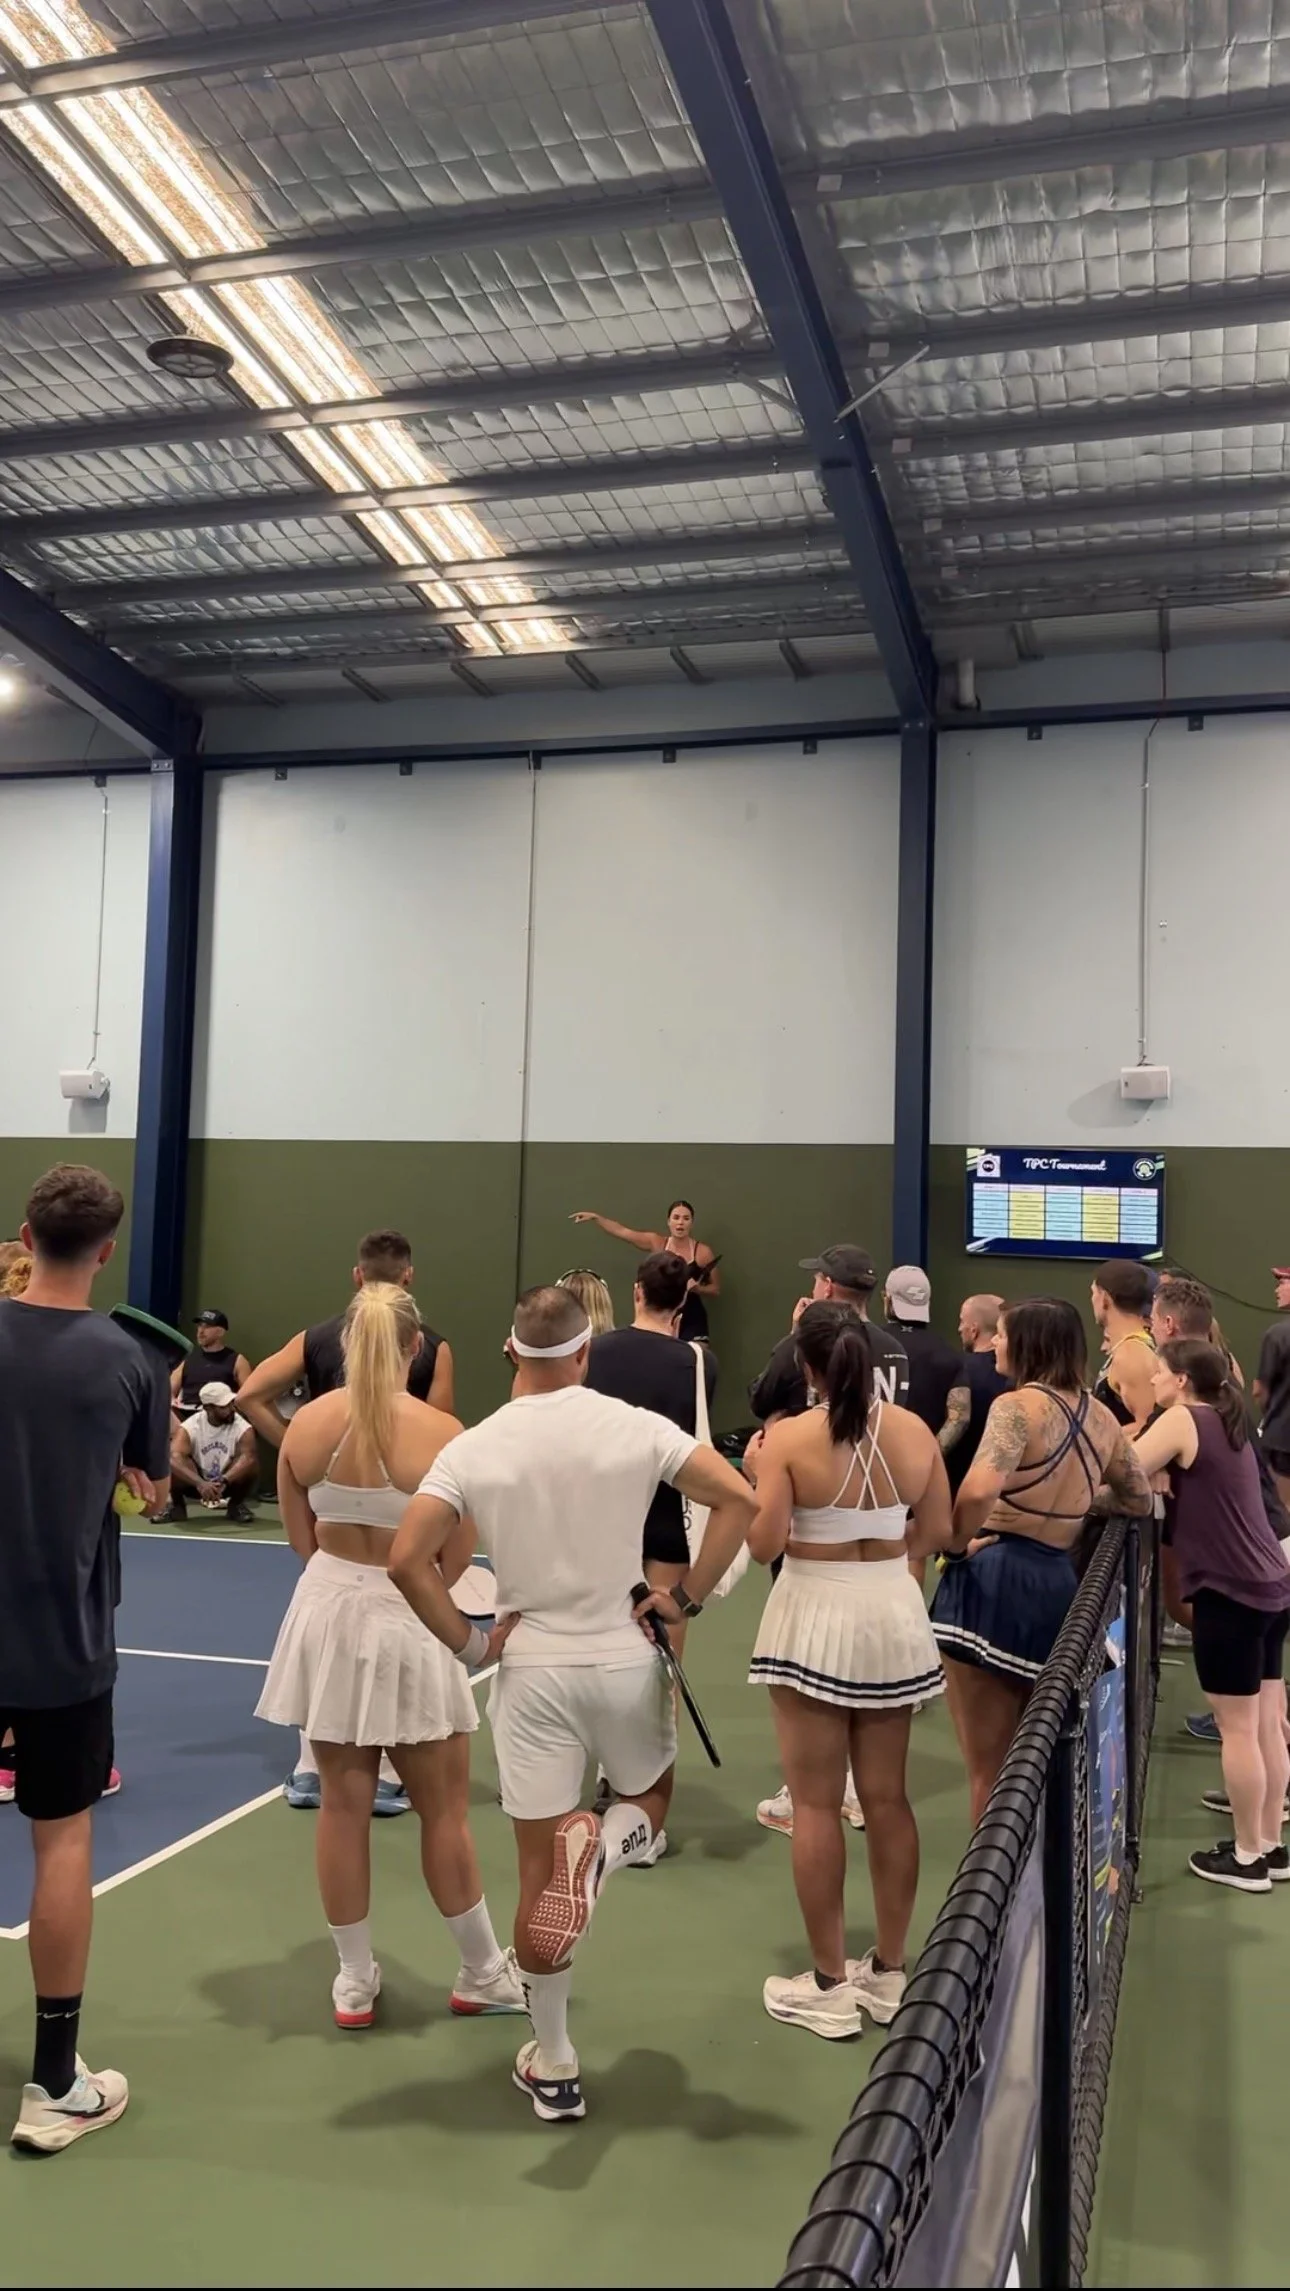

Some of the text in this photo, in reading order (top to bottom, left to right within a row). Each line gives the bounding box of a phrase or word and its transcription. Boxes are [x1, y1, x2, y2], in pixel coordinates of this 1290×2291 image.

[1023, 1157, 1107, 1171] TPC Tournament
[621, 1823, 648, 1855] true
